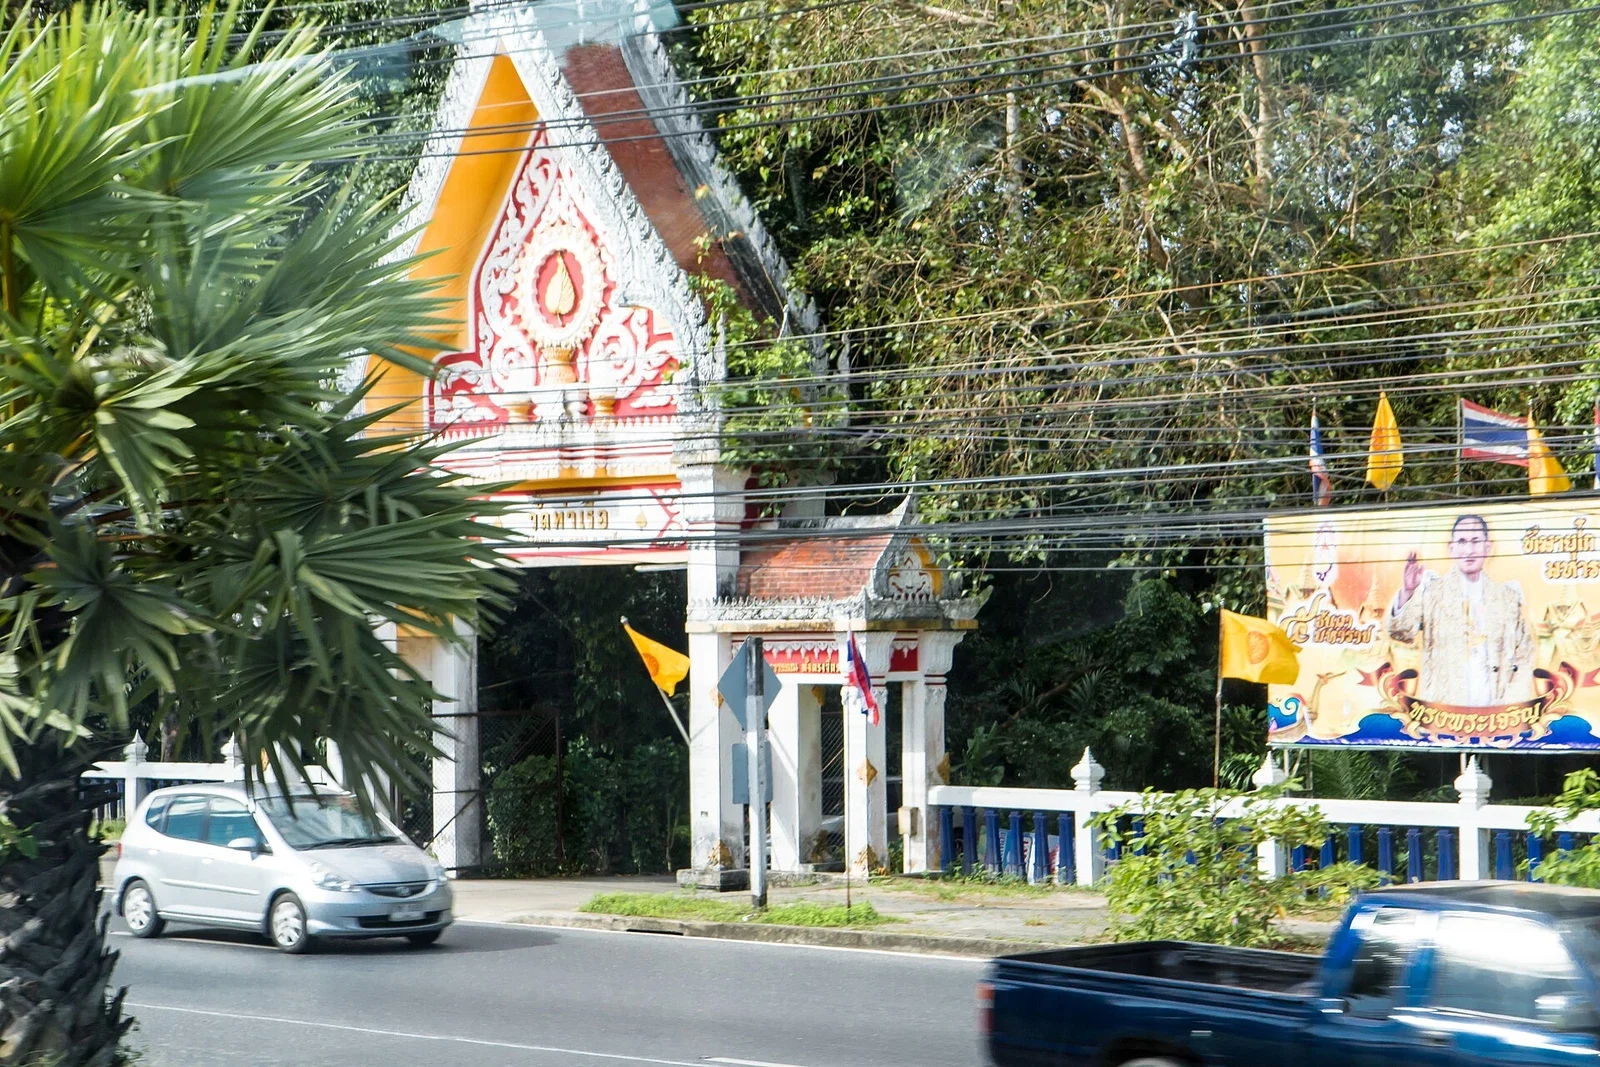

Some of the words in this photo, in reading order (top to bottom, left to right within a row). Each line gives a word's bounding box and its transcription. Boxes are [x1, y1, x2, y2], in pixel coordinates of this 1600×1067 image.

[1545, 559, 1600, 579] มหาร
[1408, 701, 1542, 733] ทรงพระเจริญ
